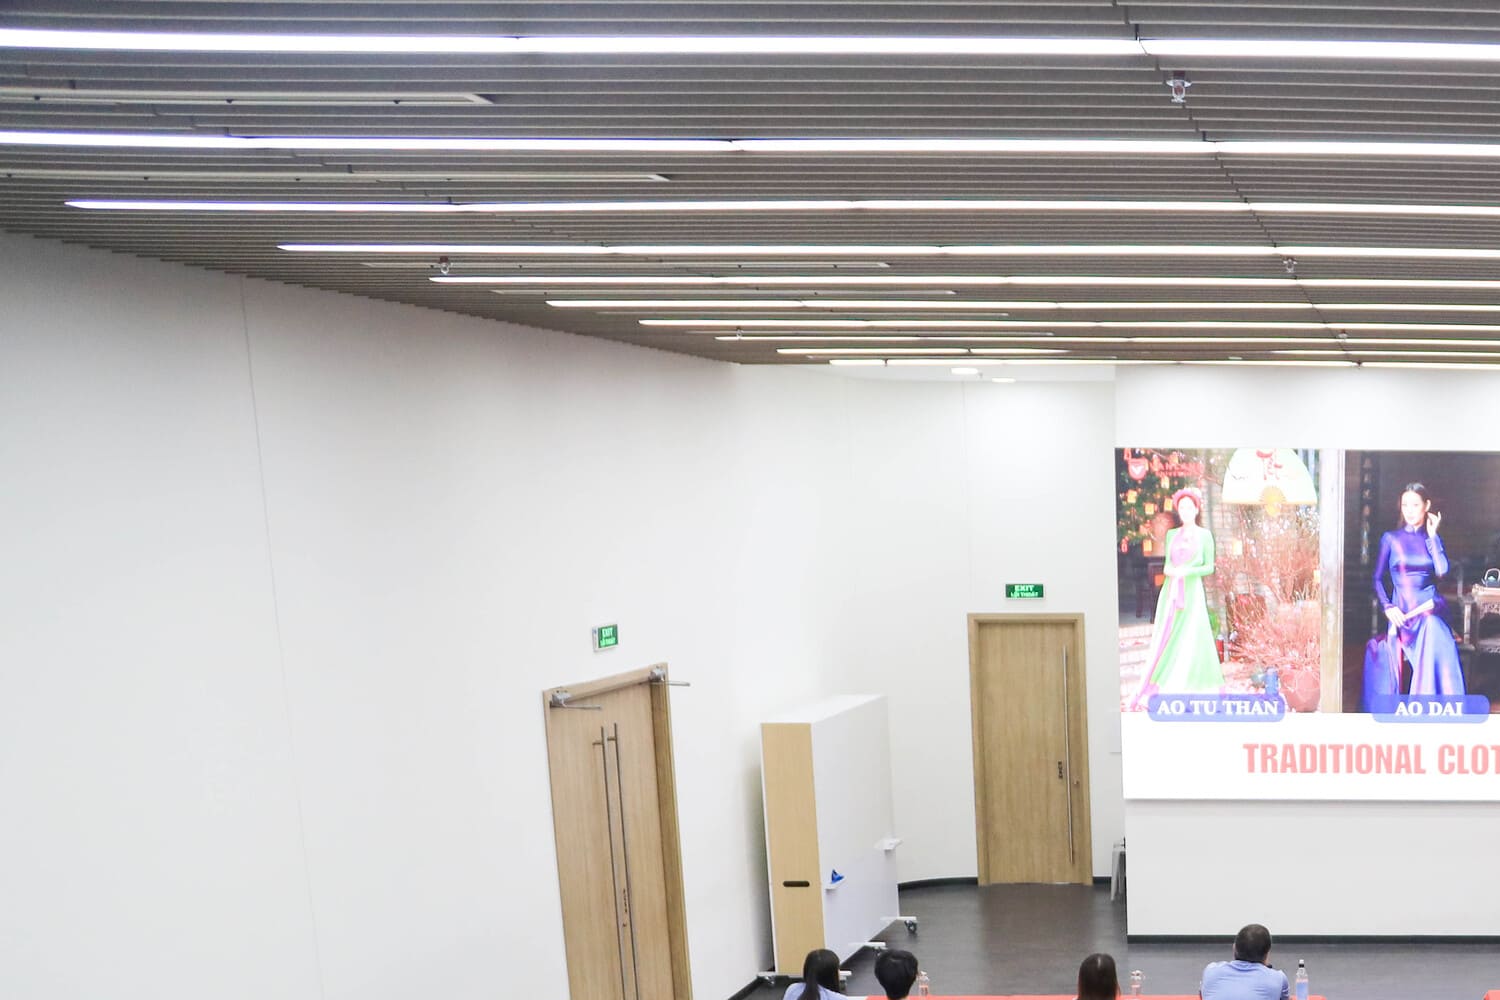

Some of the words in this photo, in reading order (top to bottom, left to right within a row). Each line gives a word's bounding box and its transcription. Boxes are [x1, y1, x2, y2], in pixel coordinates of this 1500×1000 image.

[1157, 700, 1185, 715] AO
[1190, 700, 1217, 715] TU
[1222, 700, 1279, 715] THAN
[1395, 701, 1423, 716] AO
[1428, 701, 1463, 716] DAI
[1243, 743, 1426, 775] TRADITIONAL
